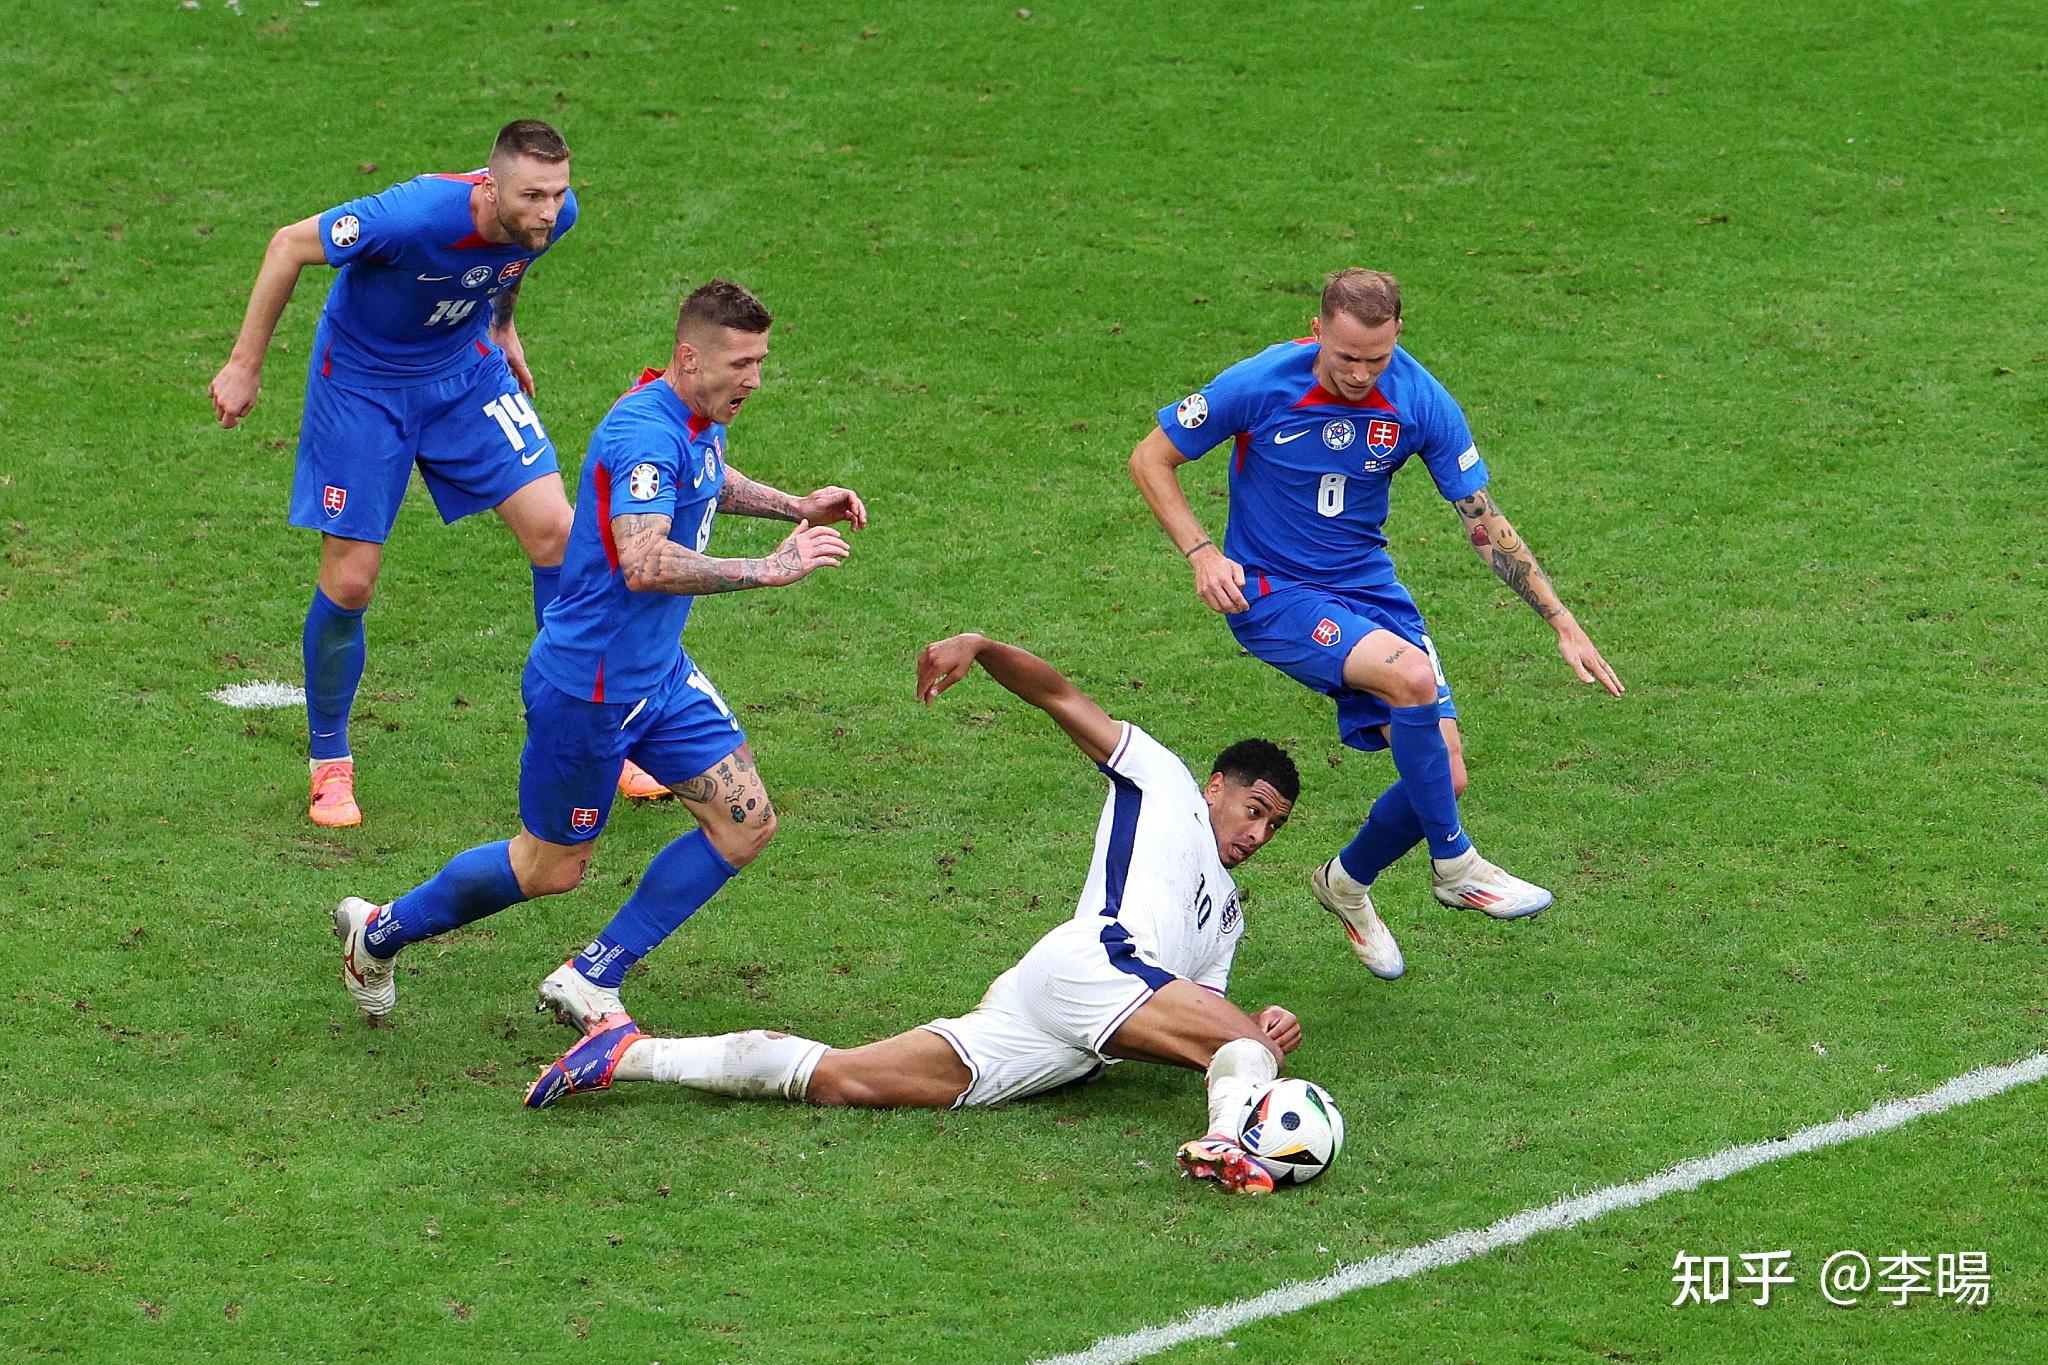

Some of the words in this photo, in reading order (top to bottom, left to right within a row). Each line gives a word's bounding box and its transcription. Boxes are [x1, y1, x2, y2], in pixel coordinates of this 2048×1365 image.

[424, 300, 477, 326] 14
[482, 392, 546, 452] 14
[1317, 473, 1348, 518] 8
[1194, 872, 1212, 931] 10
